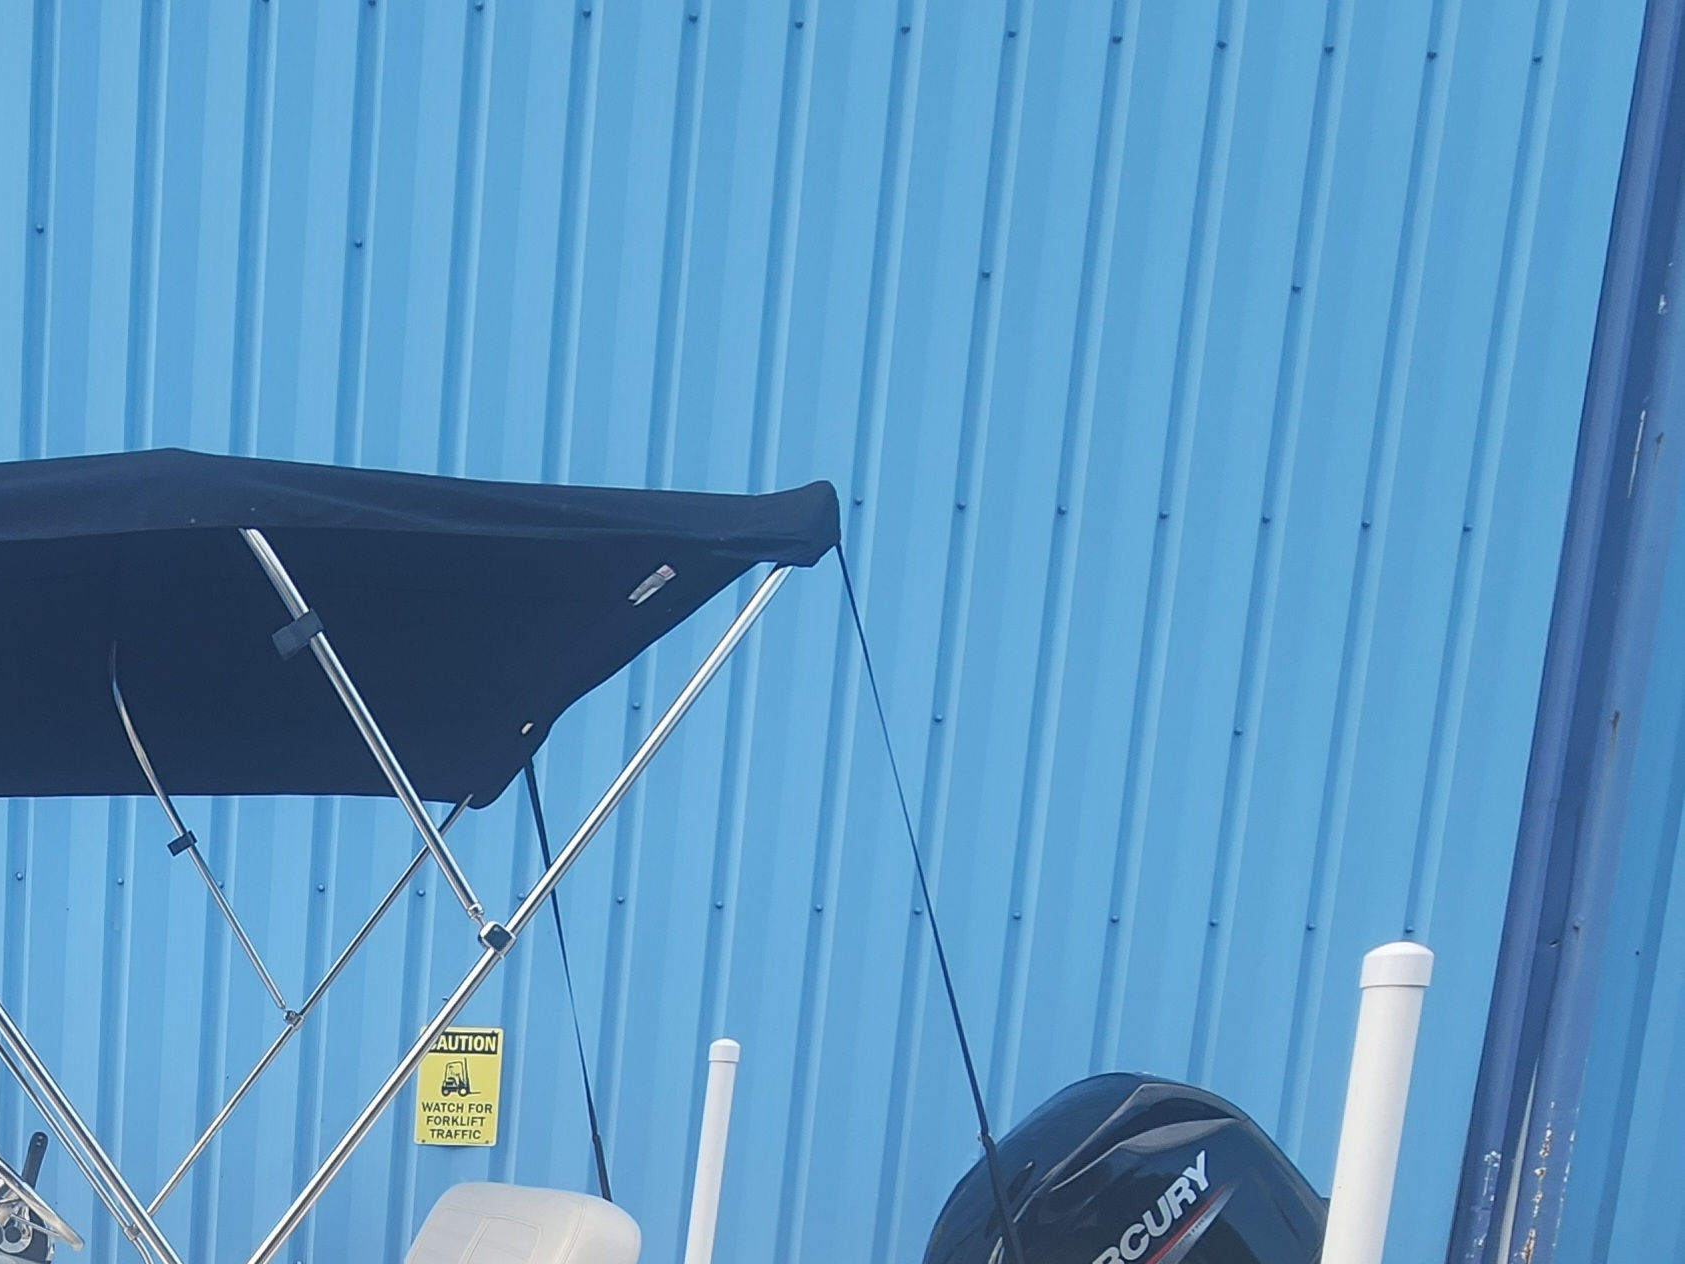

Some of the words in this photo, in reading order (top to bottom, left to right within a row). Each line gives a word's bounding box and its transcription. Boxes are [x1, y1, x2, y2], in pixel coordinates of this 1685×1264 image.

[421, 1102, 464, 1114] WATCH
[468, 1103, 493, 1114] FOR
[426, 1115, 486, 1127] FORKLIFT
[429, 1128, 482, 1140] TRAFFIC
